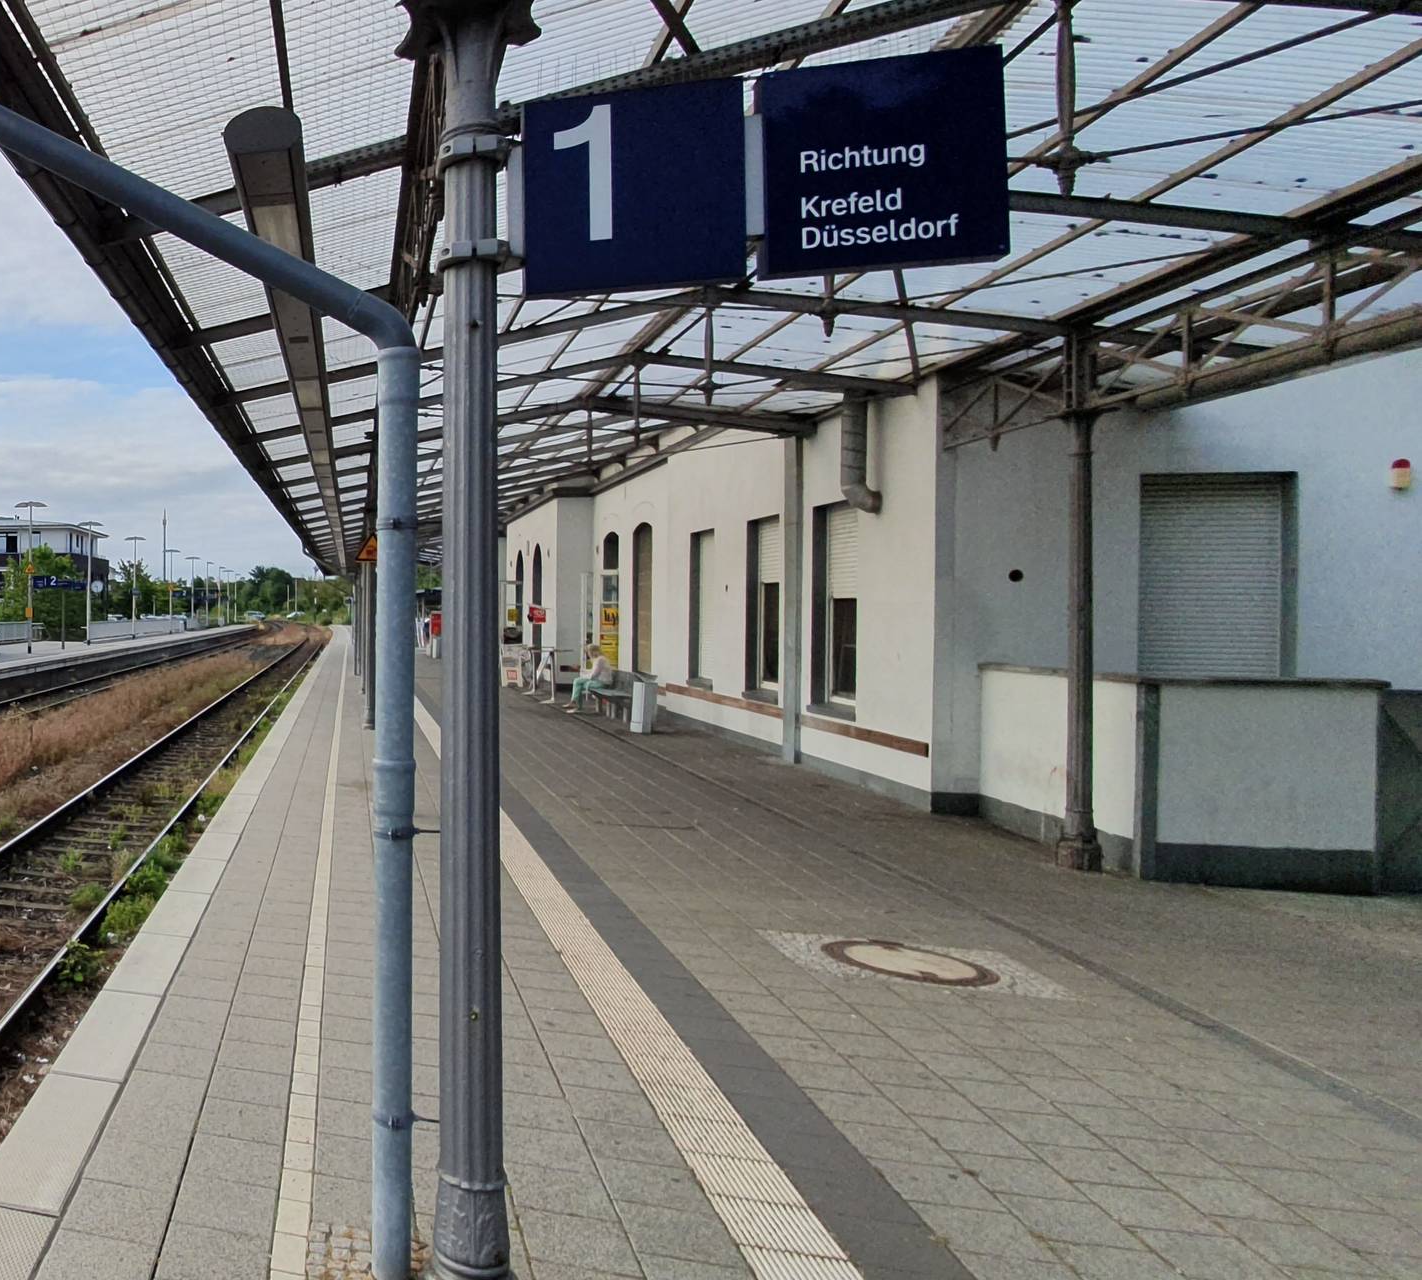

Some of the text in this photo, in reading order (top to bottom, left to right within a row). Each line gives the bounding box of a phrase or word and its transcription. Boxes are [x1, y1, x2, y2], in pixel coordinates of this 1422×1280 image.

[554, 104, 612, 240] 1
[800, 144, 925, 173] Richtung
[801, 188, 902, 219] Krefeld
[801, 213, 959, 250] Düsseldorf
[50, 575, 57, 586] 2
